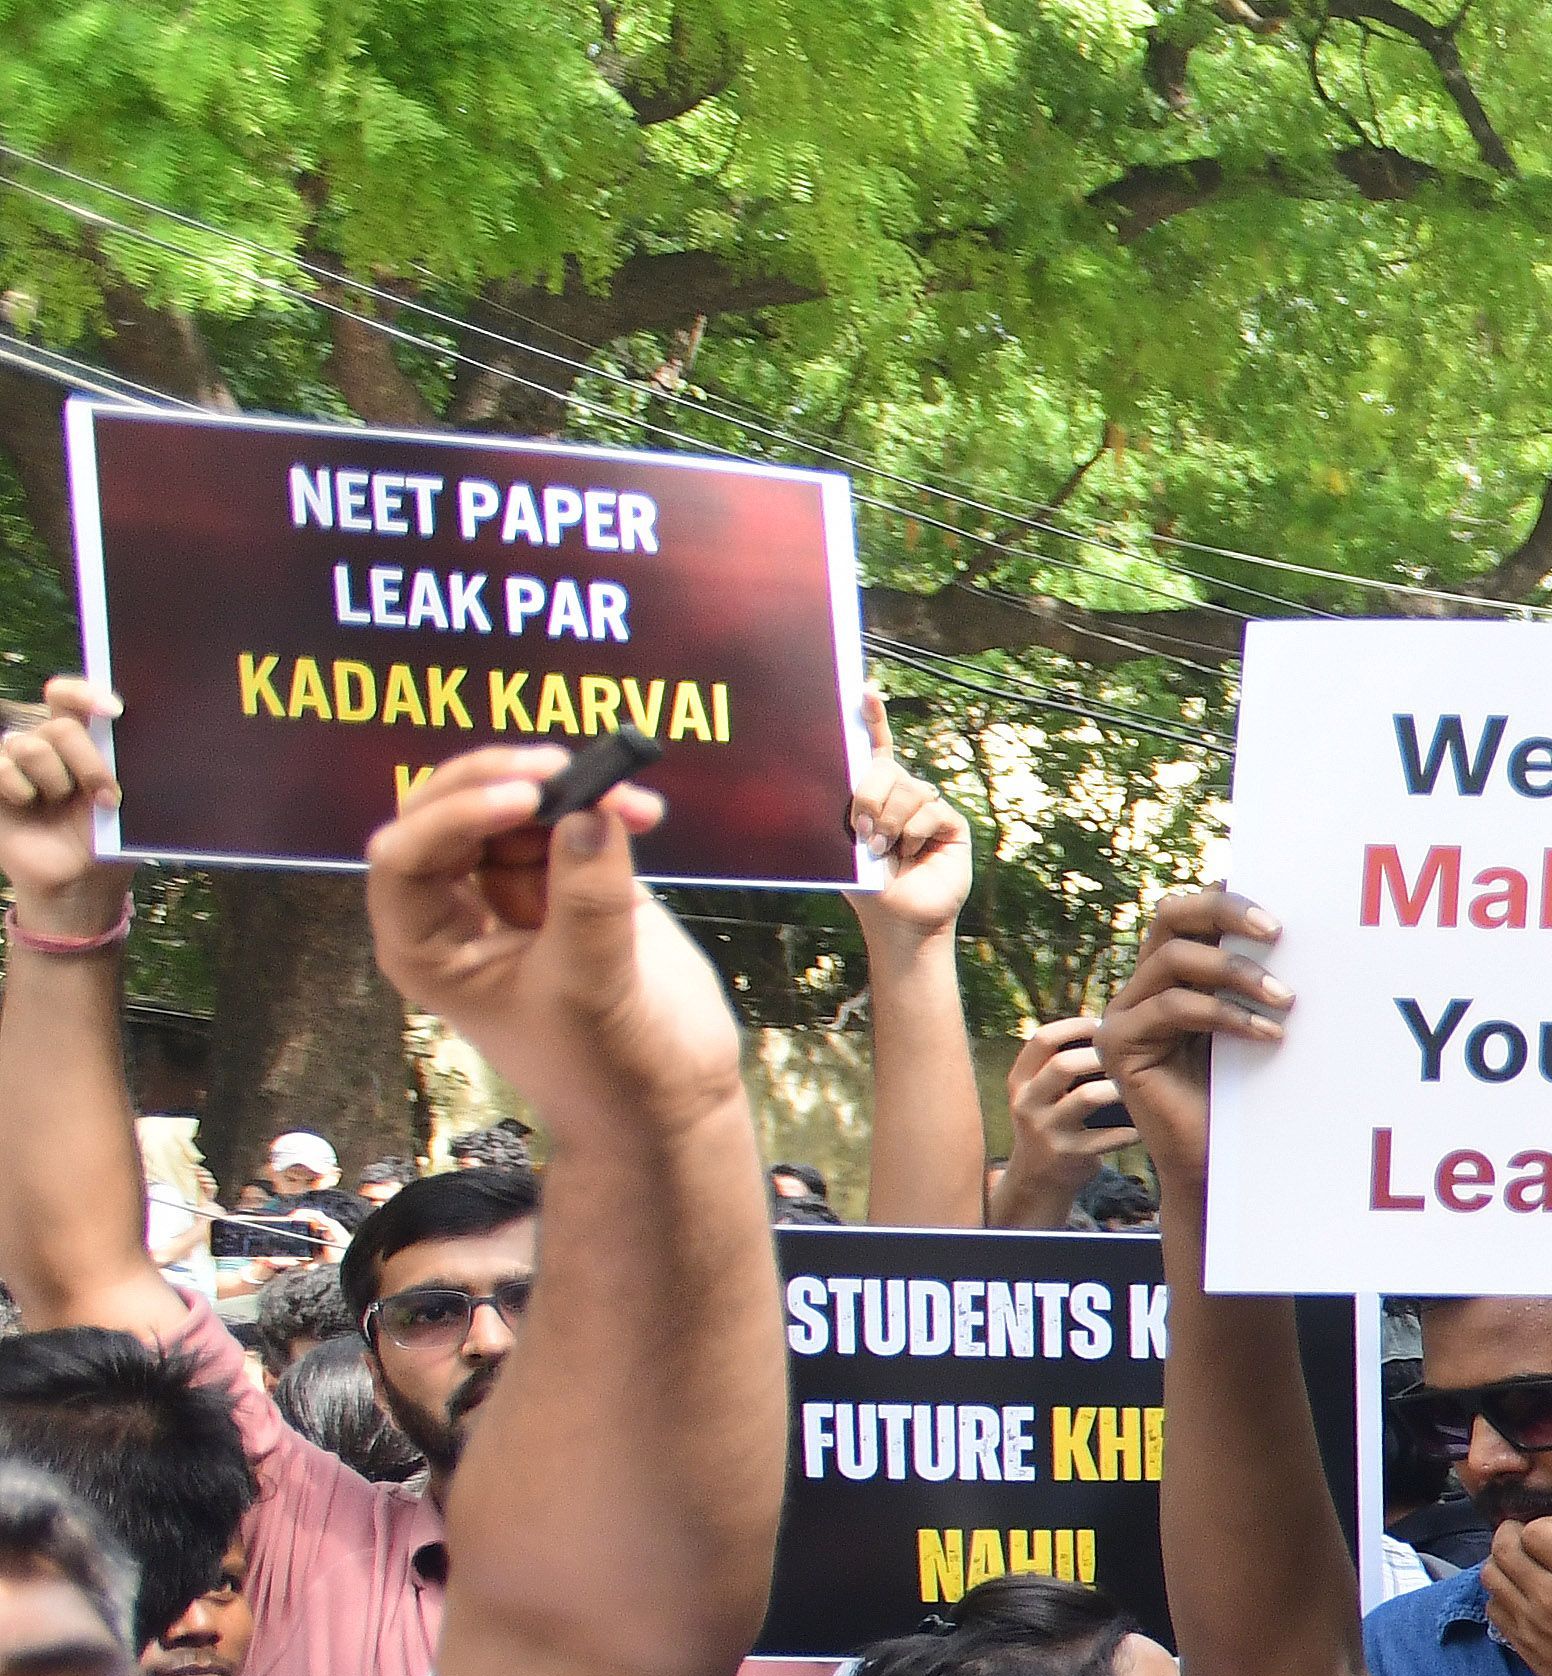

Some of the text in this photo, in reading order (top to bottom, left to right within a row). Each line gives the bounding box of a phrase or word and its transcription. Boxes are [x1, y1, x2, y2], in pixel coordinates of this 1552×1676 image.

[289, 465, 658, 554] NEET PAPER
[334, 563, 629, 641] LEAK PAR
[238, 652, 730, 741] KADAK KARVAI
[787, 1276, 1112, 1358] STUDENTS
[802, 1403, 1035, 1481] FUTURE
